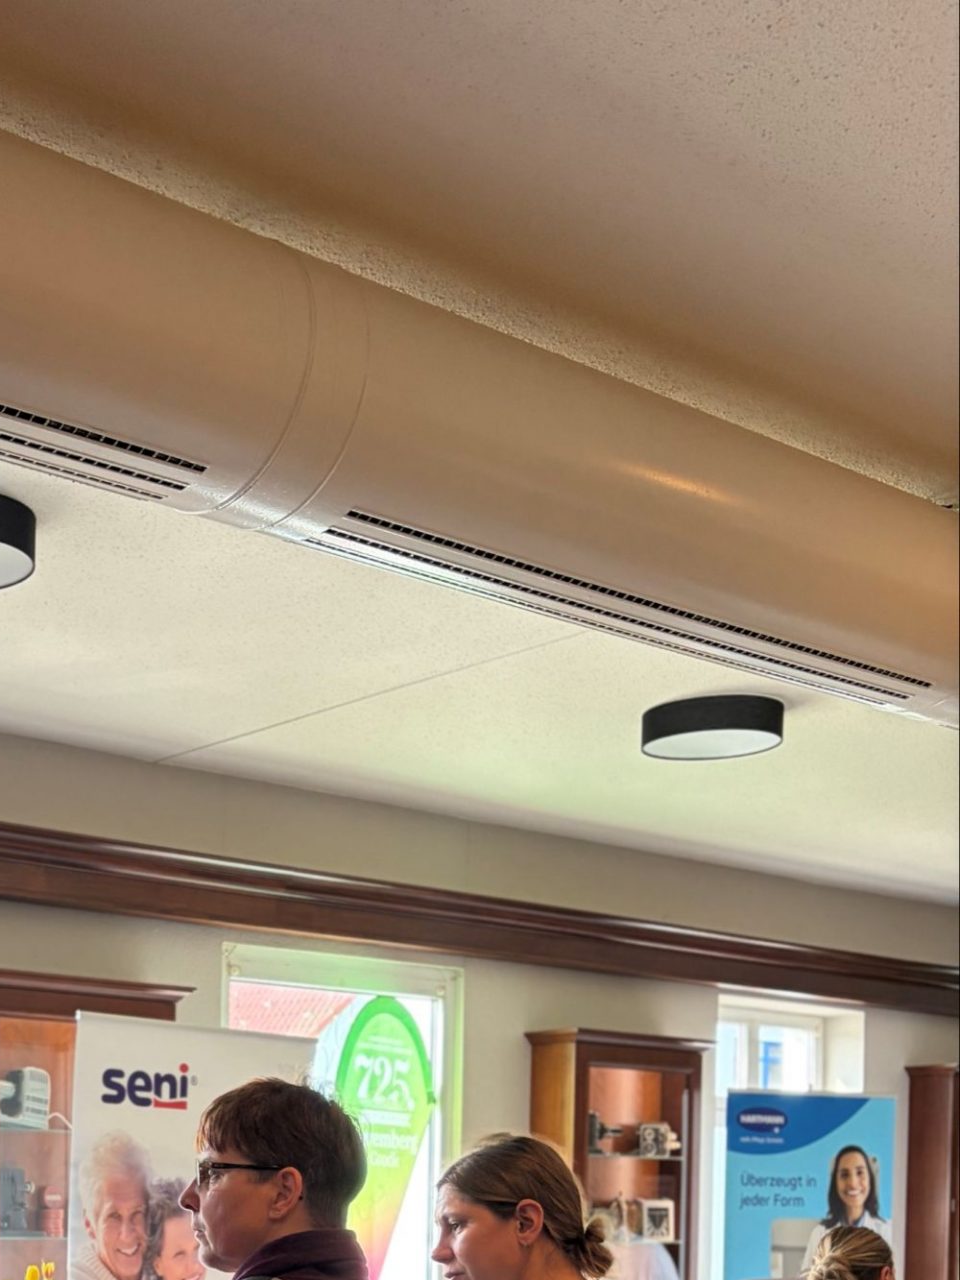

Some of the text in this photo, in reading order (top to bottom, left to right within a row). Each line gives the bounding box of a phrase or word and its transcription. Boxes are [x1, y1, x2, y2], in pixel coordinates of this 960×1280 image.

[101, 1063, 189, 1108] seni
[354, 1053, 416, 1111] 725
[740, 1170, 817, 1191] Überzeugt in
[739, 1193, 805, 1210] jeder Form
